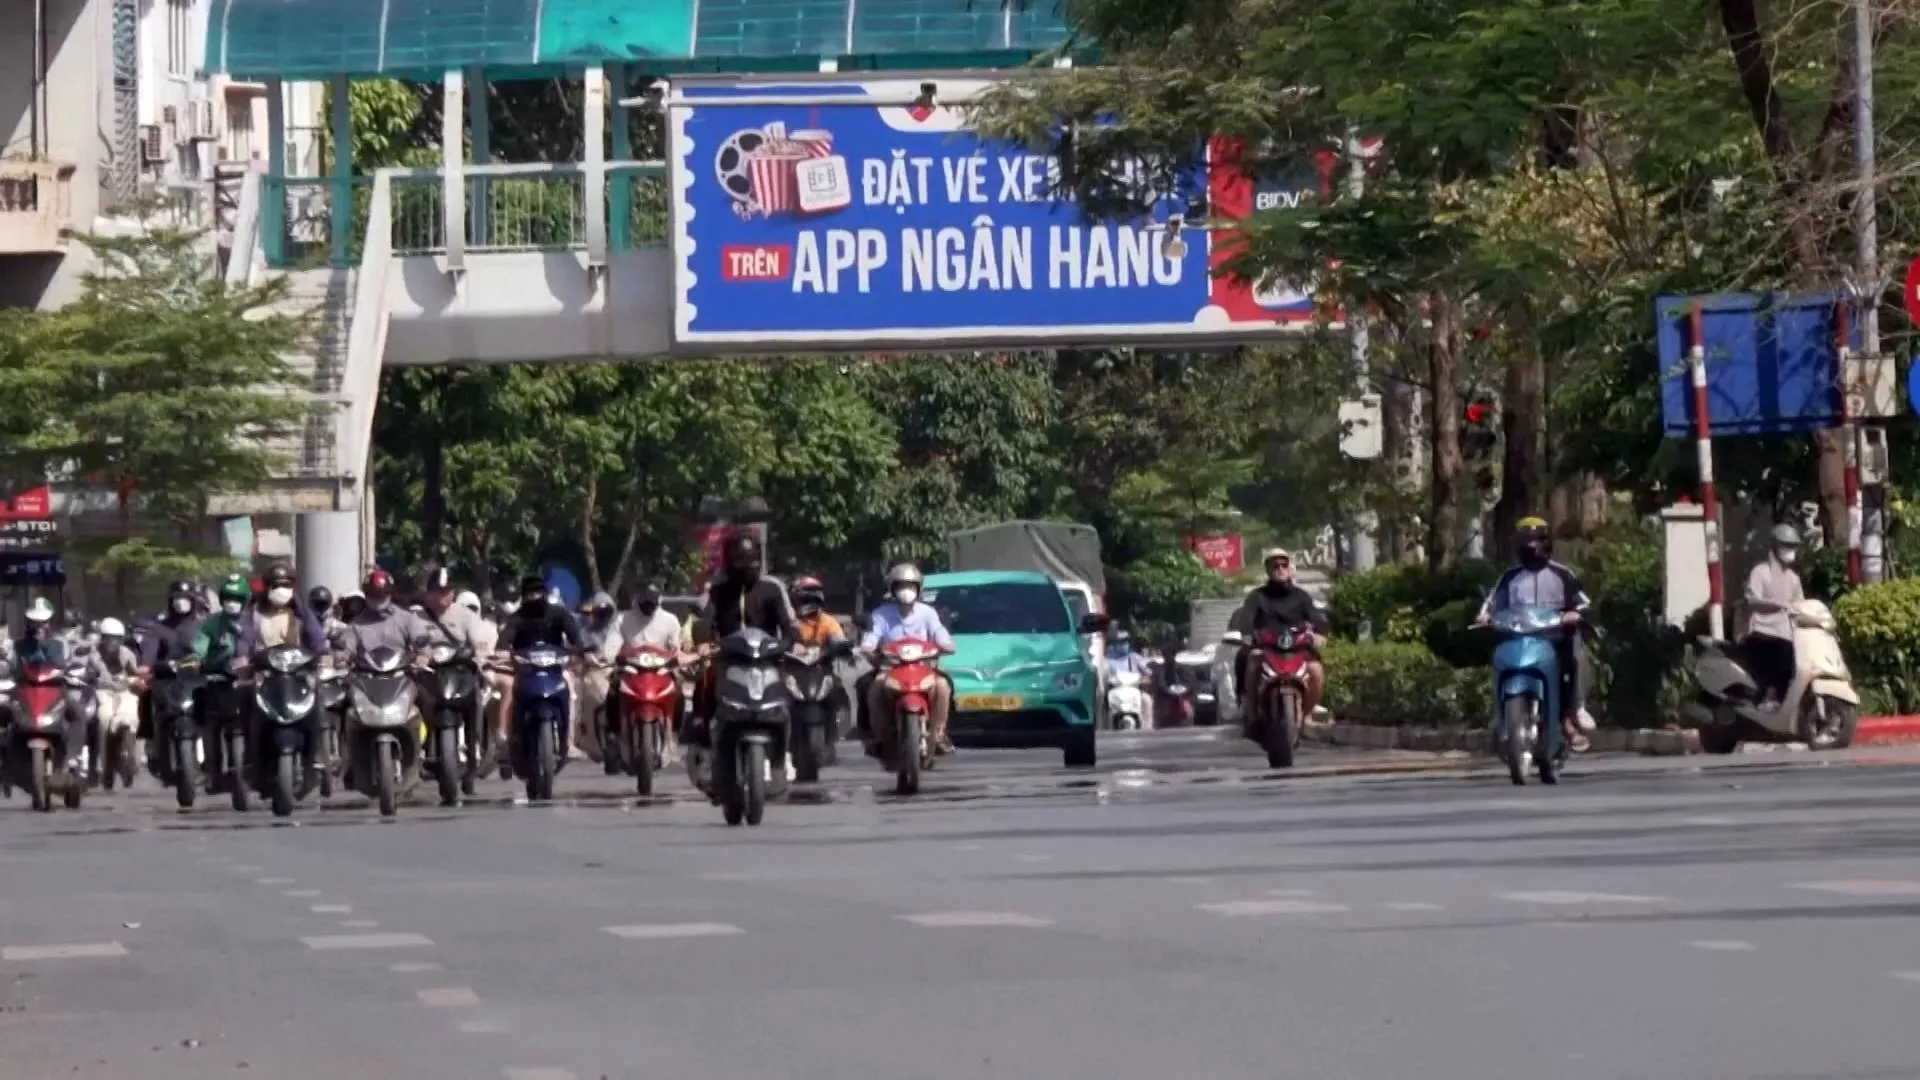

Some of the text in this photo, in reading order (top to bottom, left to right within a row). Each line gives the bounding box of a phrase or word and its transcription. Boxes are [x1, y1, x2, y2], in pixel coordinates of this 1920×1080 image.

[862, 149, 933, 214] ĐẶT
[1256, 191, 1300, 210] BIDV
[729, 248, 780, 276] TRÊN
[792, 229, 888, 293] APP
[902, 214, 1033, 292] NGÂN
